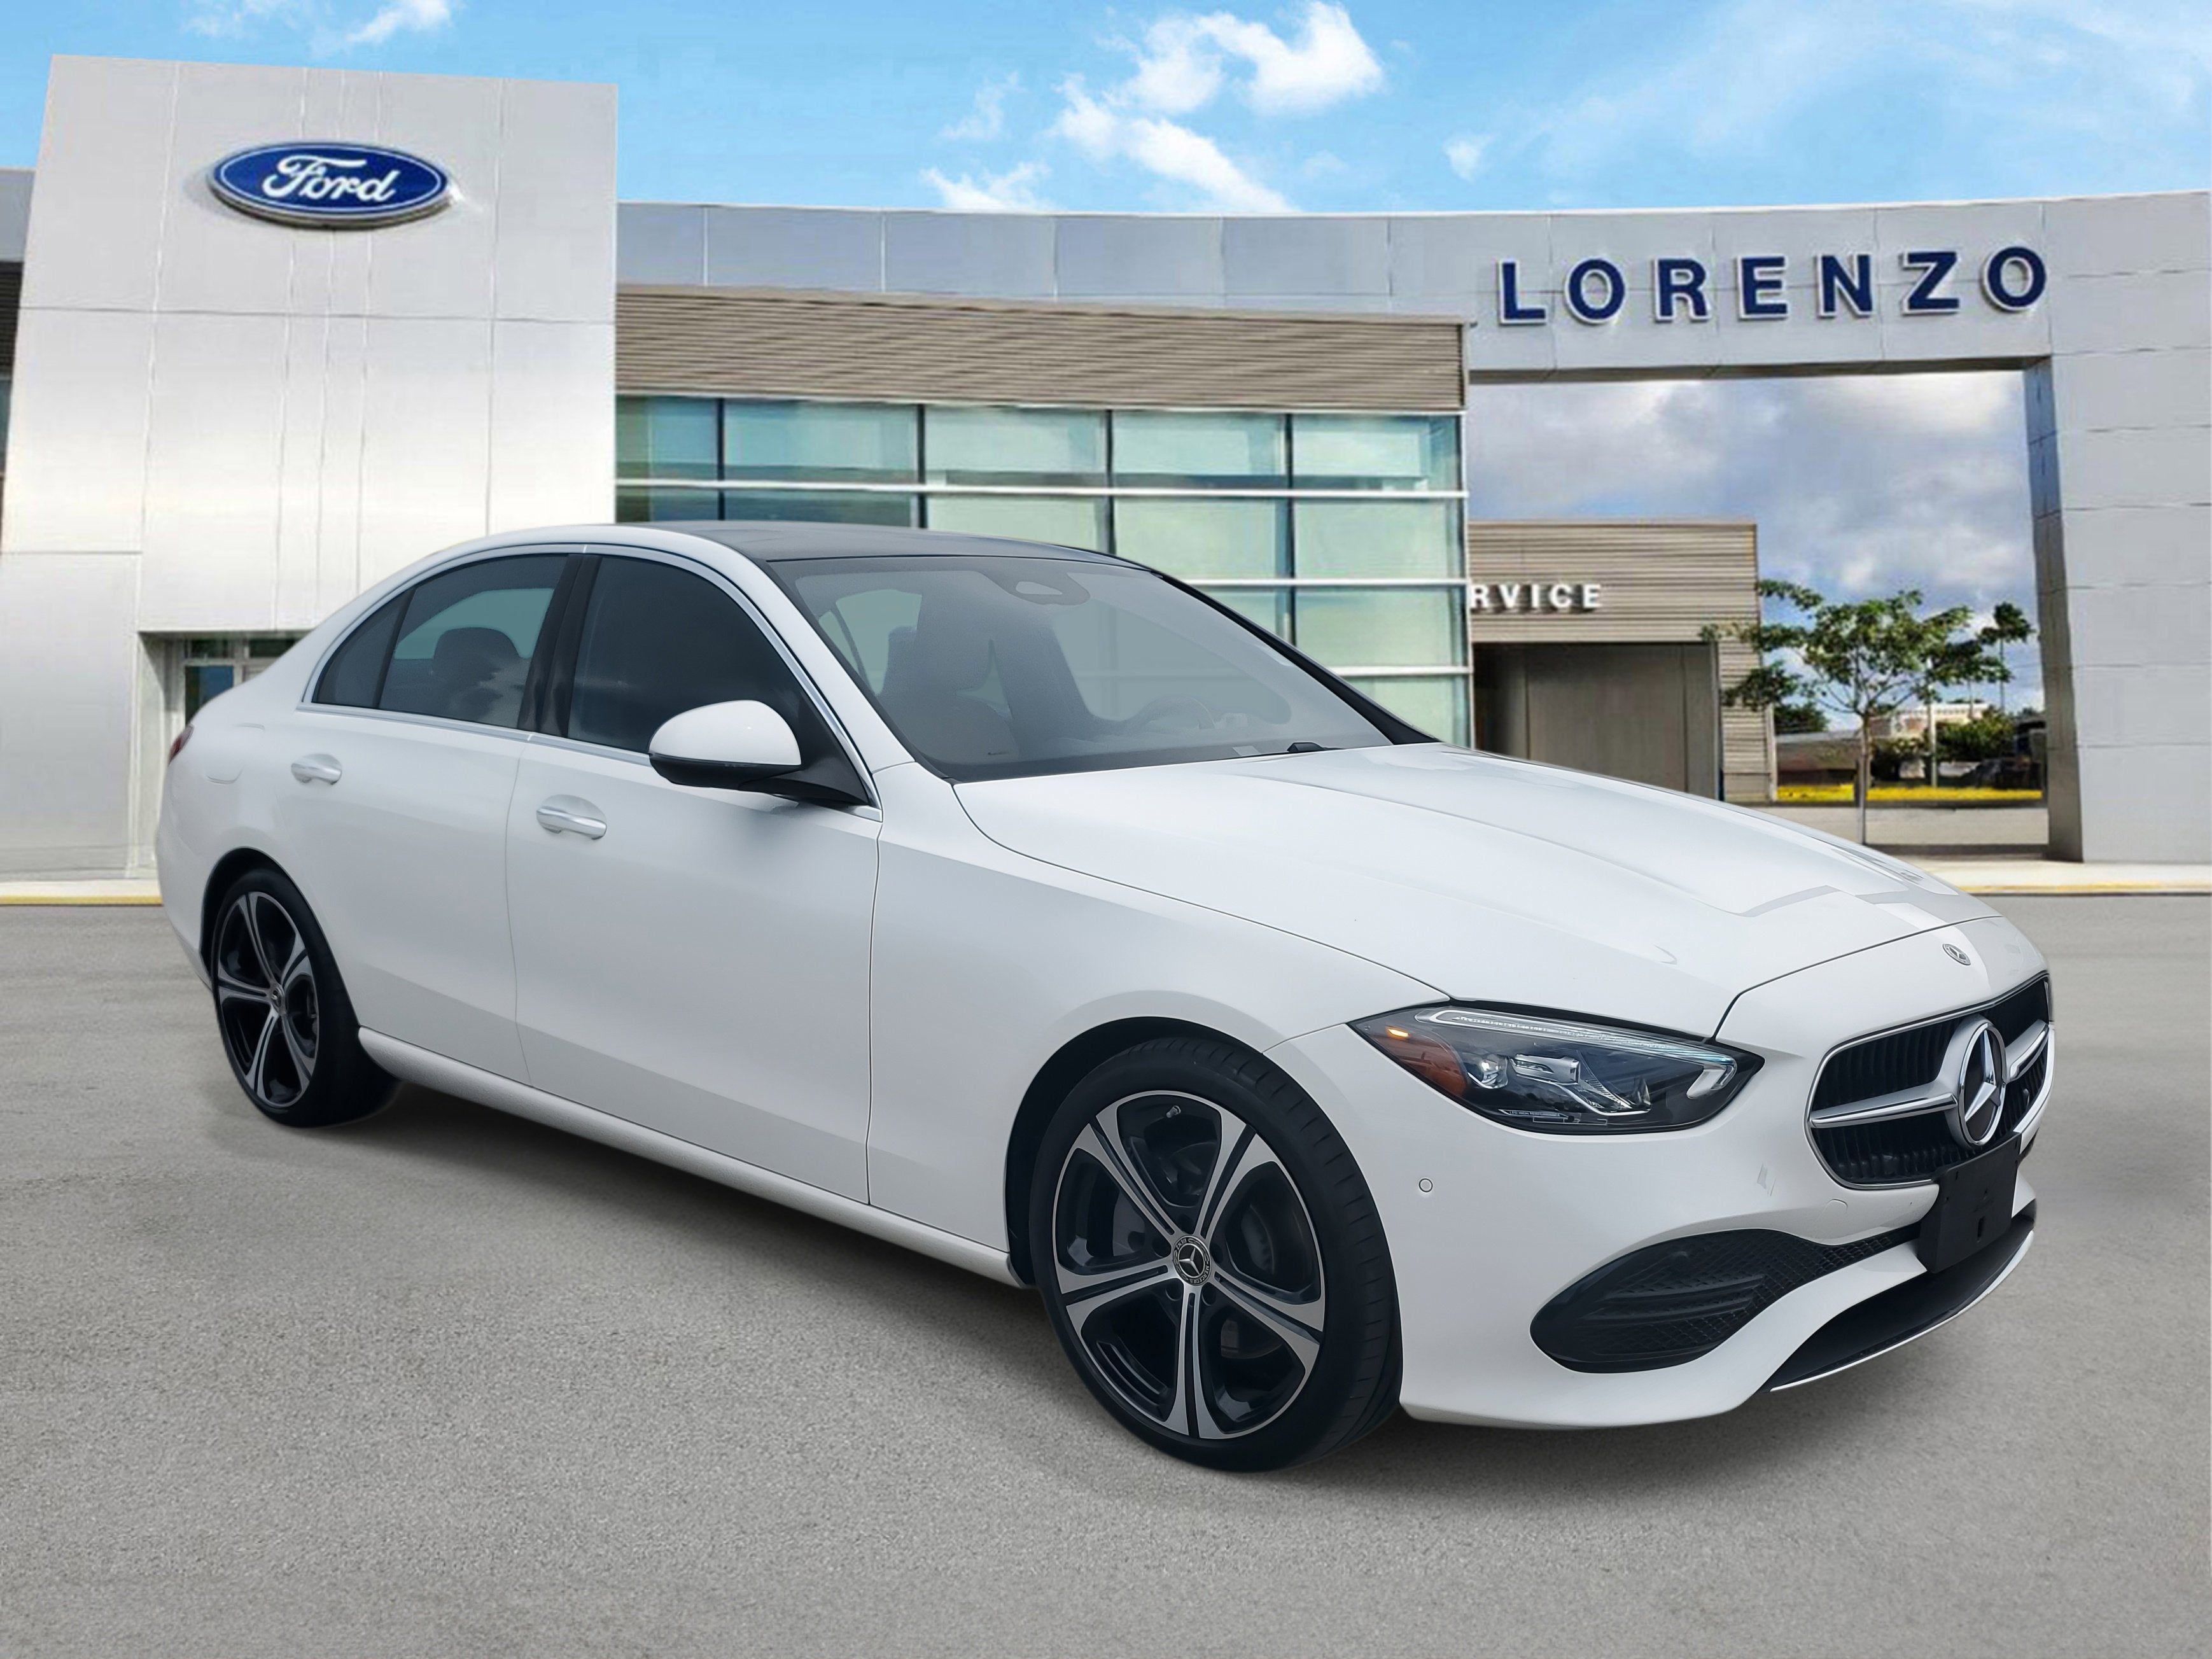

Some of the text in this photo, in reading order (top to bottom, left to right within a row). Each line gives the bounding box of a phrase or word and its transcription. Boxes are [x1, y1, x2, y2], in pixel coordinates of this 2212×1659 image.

[262, 154, 400, 202] Ford
[1497, 246, 2047, 325] LORENZO
[1470, 584, 1602, 609] RVICE
